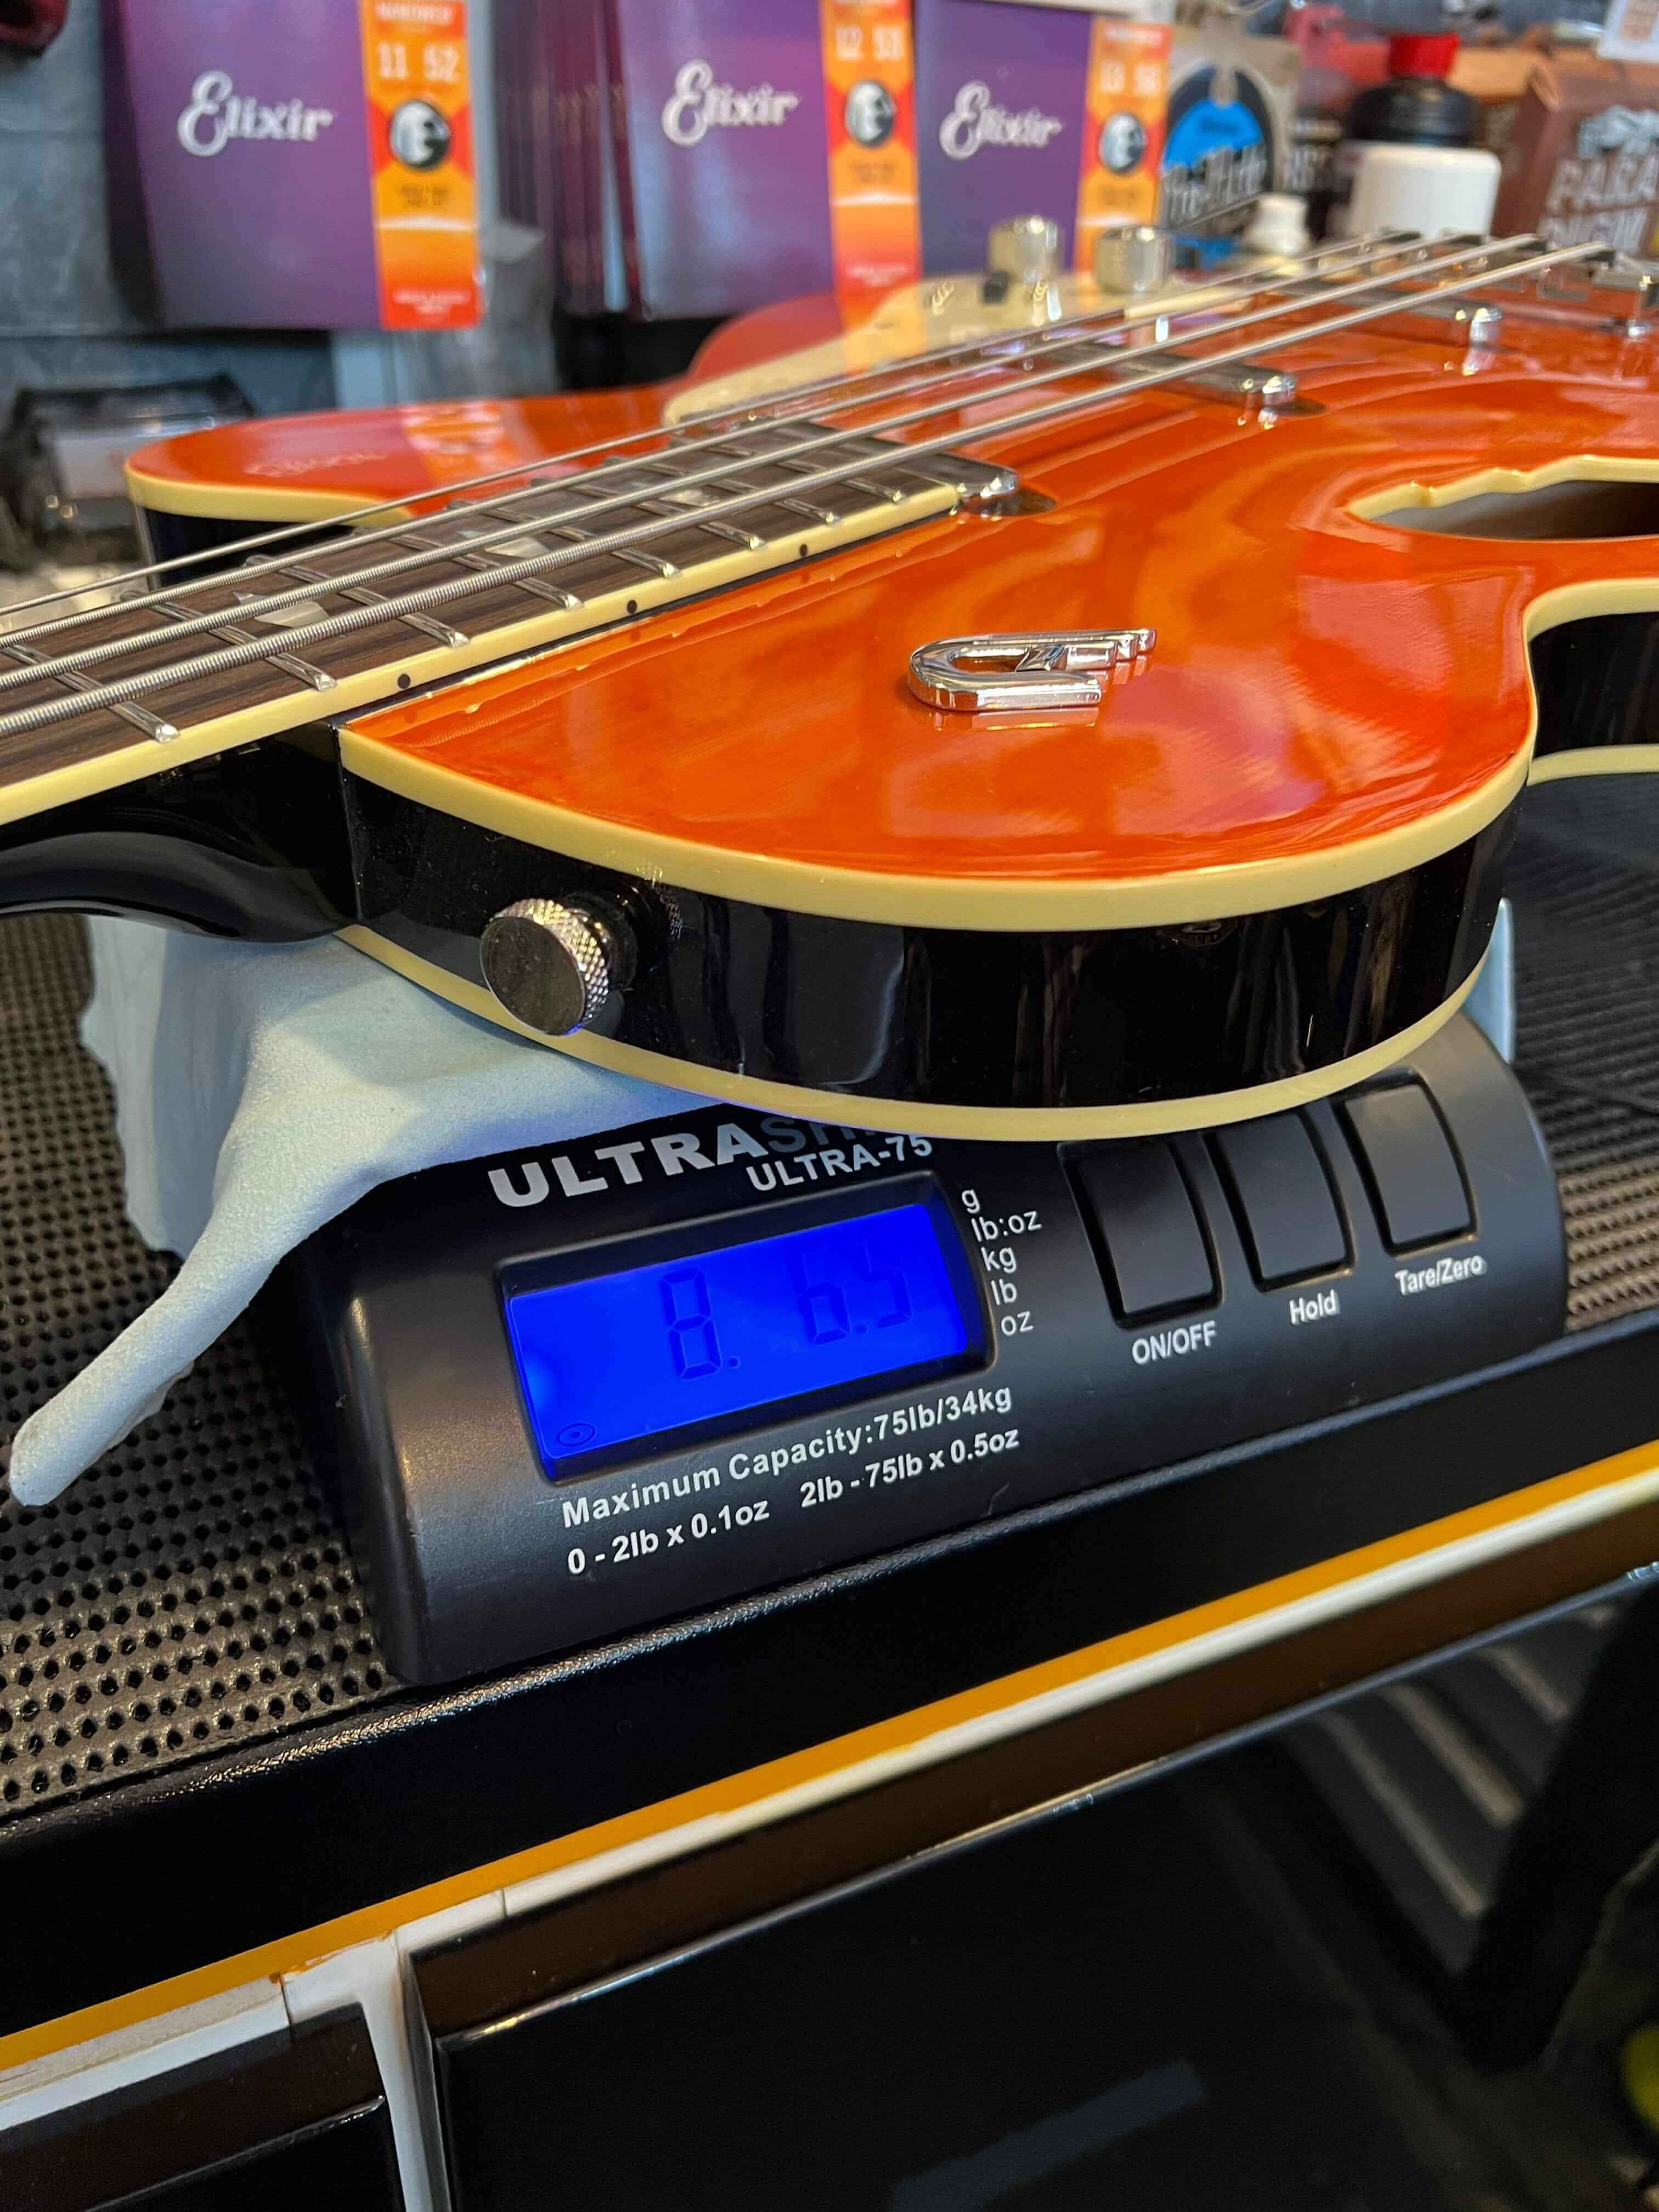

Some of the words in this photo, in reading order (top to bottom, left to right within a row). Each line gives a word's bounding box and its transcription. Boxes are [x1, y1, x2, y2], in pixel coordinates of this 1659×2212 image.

[377, 43, 408, 80] 11
[177, 70, 333, 156] Elixir
[662, 59, 799, 146] Elixir
[939, 80, 1062, 161] Elixir
[745, 1132, 933, 1192] ULTRA-75
[961, 1189, 980, 1214] g
[970, 1210, 1042, 1243] lb:oz
[980, 1246, 1017, 1273] kg
[1395, 1255, 1487, 1295] Tare/Zero
[990, 1278, 1018, 1306] lb
[1289, 1289, 1340, 1325] Hold
[1000, 1311, 1034, 1336] oz
[1131, 1320, 1217, 1365] ON/OFF
[561, 1466, 721, 1528] Maximum
[567, 1547, 586, 1575] 0
[611, 1529, 659, 1563] 2lb
[667, 1524, 685, 1547] x
[691, 1499, 770, 1539] 0.1oz
[799, 1476, 844, 1508] 2lb
[865, 1453, 923, 1483] 75lb
[929, 1449, 945, 1471] x
[950, 1429, 1020, 1464] 0.5oz
